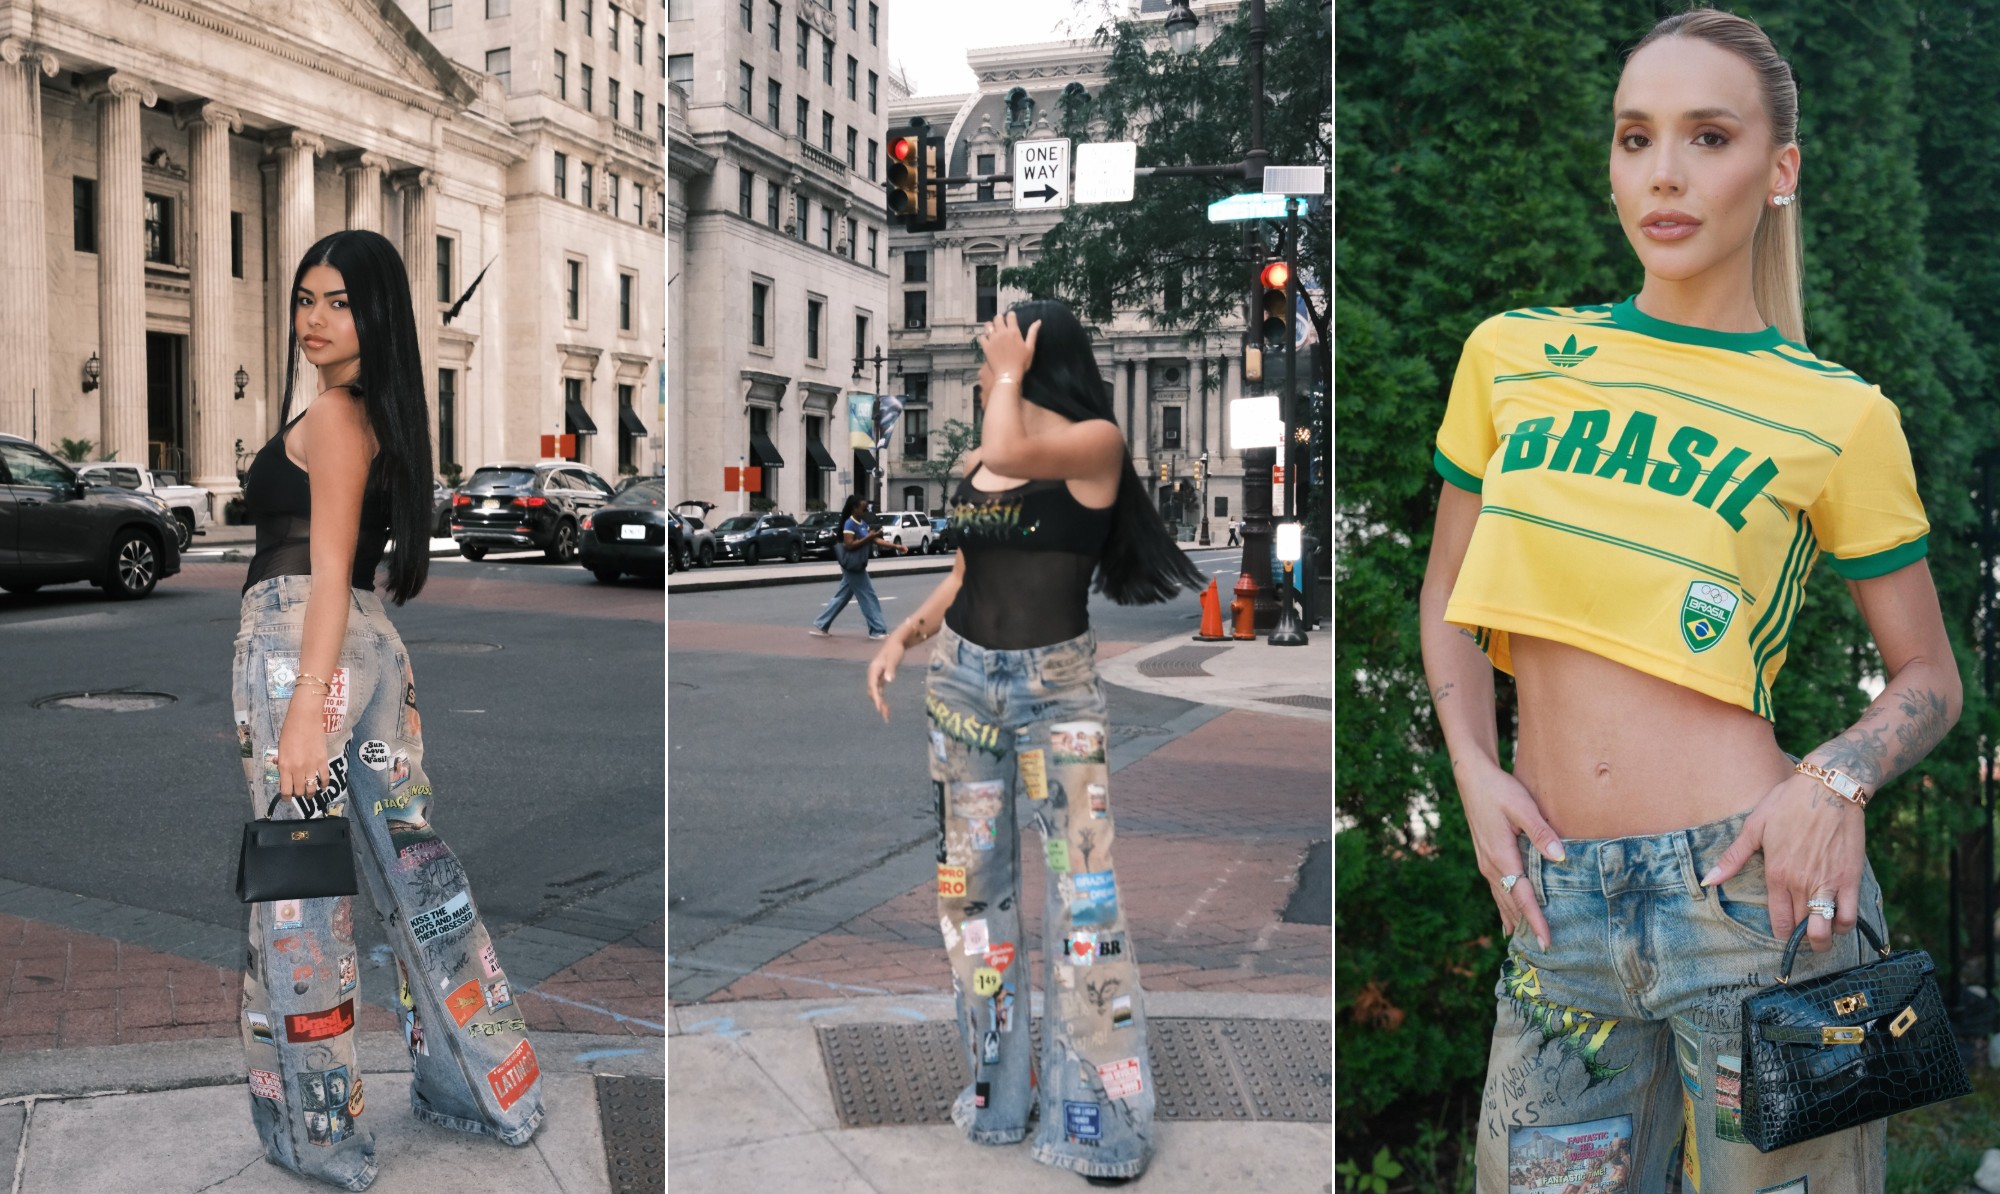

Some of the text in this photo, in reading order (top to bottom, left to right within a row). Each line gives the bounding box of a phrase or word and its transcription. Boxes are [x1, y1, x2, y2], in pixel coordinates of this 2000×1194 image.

[1025, 146, 1058, 163] ONE
[1023, 164, 1059, 181] WAY
[1501, 409, 1779, 533] BRASIL
[1688, 599, 1727, 621] BRASIL
[362, 754, 387, 764] Brasil
[410, 906, 448, 928] KISS THE
[413, 902, 471, 937] BOYS AND MAKE
[416, 911, 473, 945] THEM OBSESSED
[1100, 939, 1121, 956] BR
[293, 1007, 341, 1034] Brasil
[1502, 1080, 1527, 1107] NOT
[1487, 1100, 1540, 1140] KISS
[1567, 1131, 1609, 1145] FANTASTIC
[1579, 1143, 1594, 1152] RIO
[1569, 1149, 1605, 1162] WEEKEND
[1542, 1173, 1586, 1185] FANTASTIC
